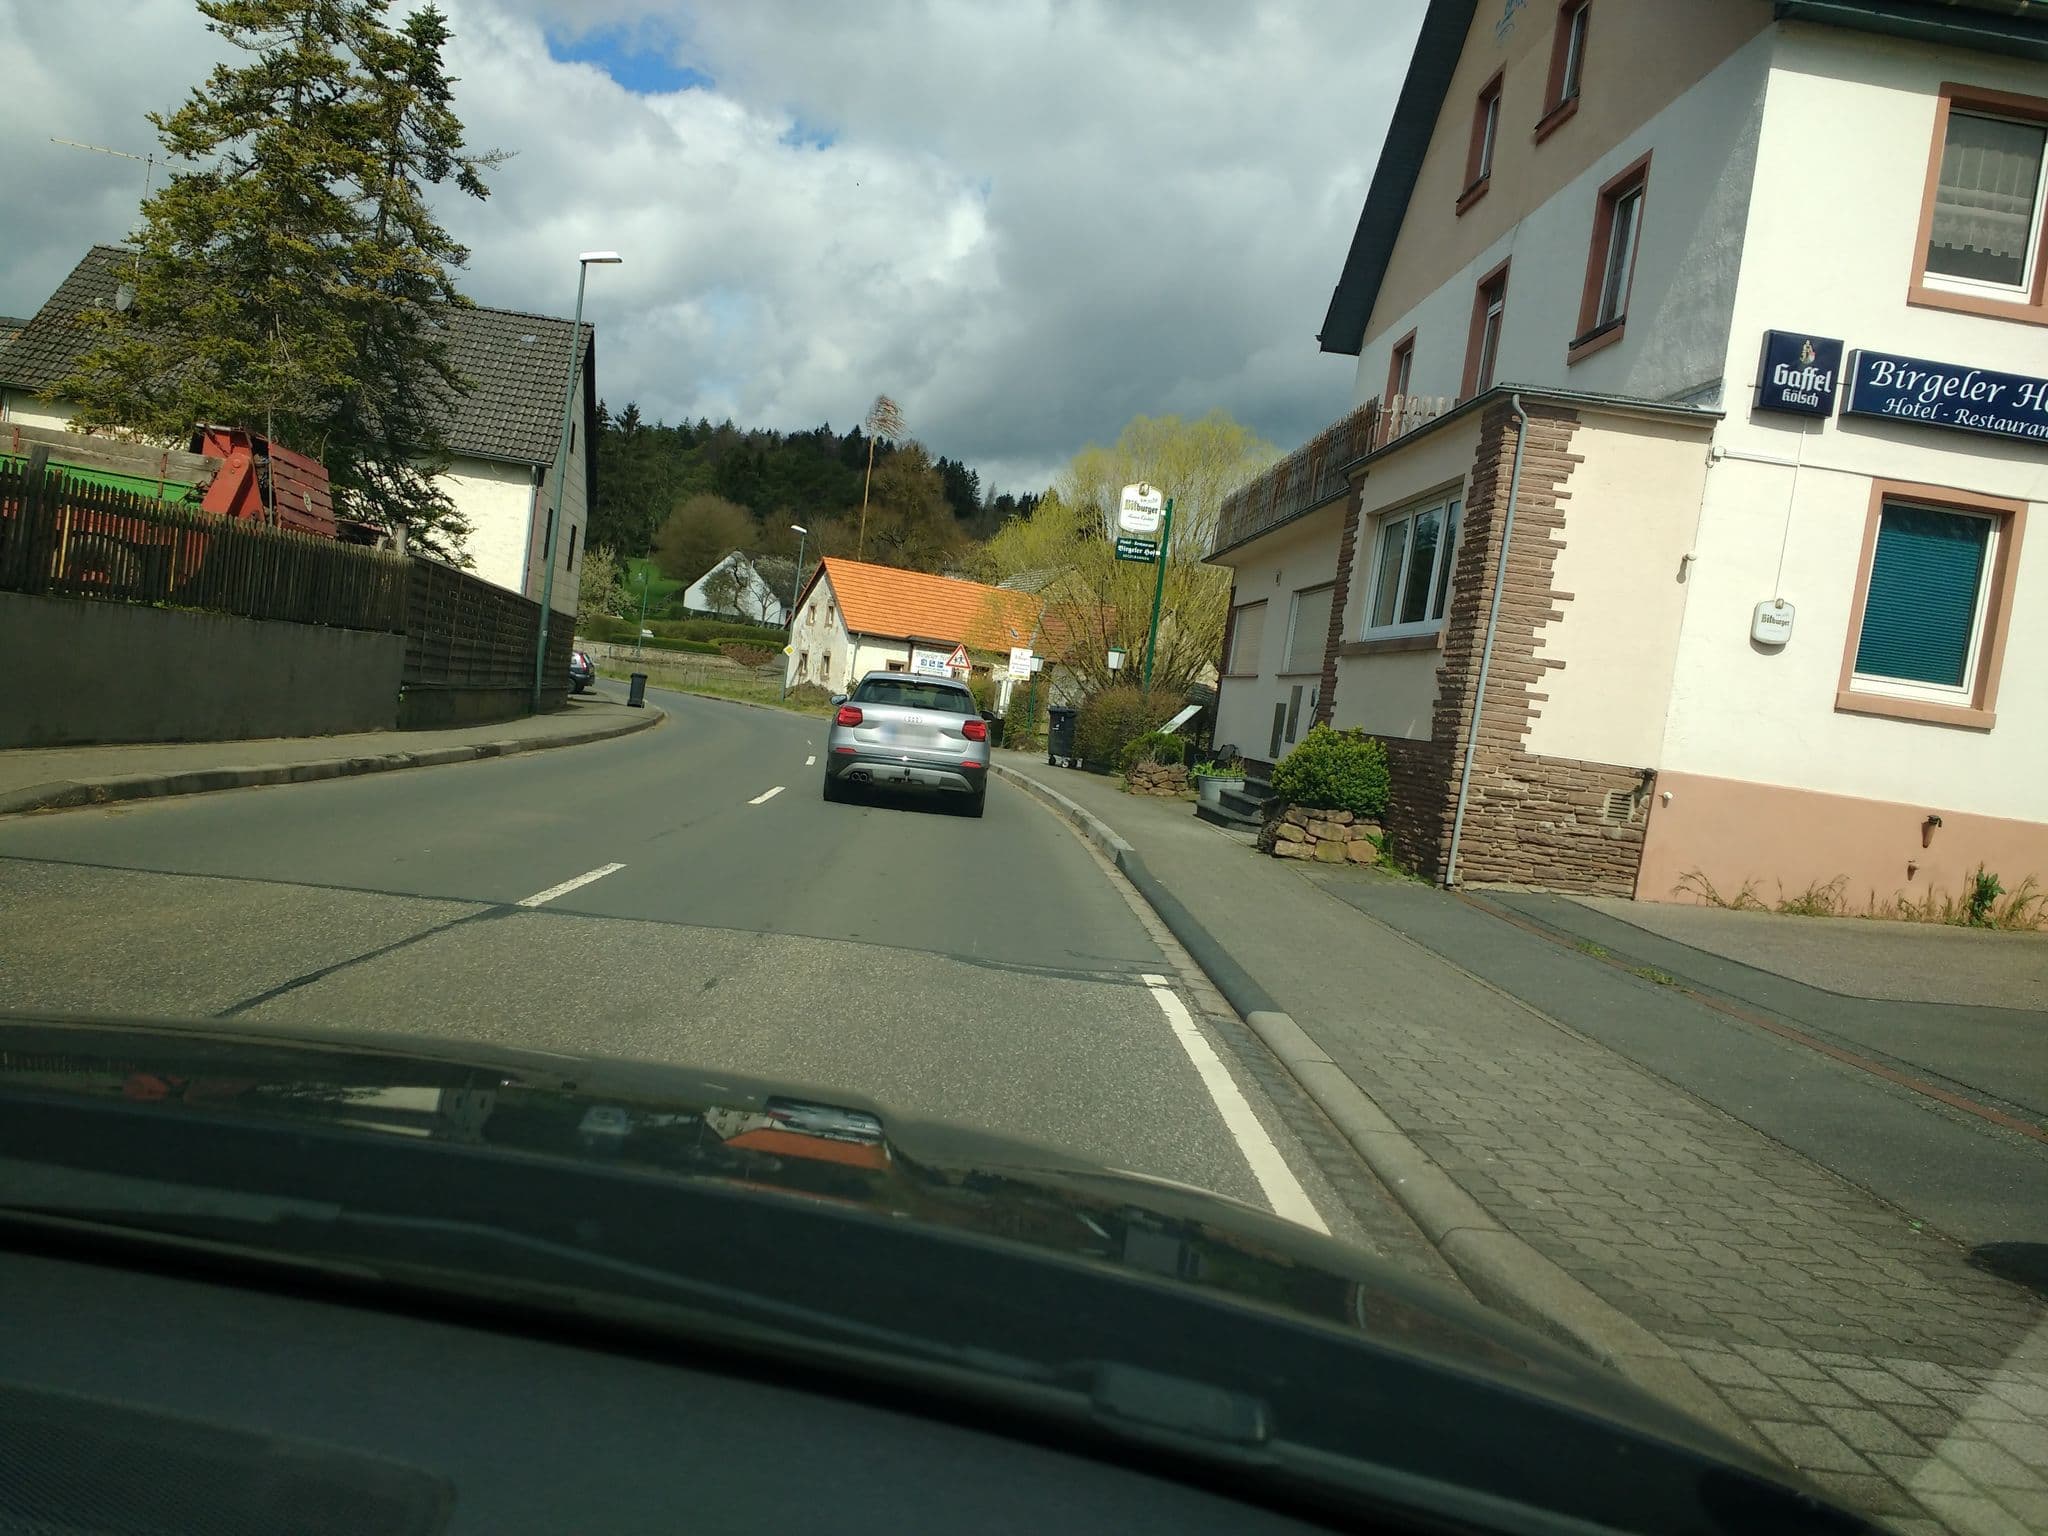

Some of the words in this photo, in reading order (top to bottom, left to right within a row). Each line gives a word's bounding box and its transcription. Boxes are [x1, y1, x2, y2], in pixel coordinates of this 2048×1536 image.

[1773, 363, 1832, 393] Gaffel
[1869, 360, 2007, 403] Birgeler
[2012, 383, 2048, 412] H
[1782, 388, 1819, 408] Kölsch
[1882, 397, 1944, 420] Hotel
